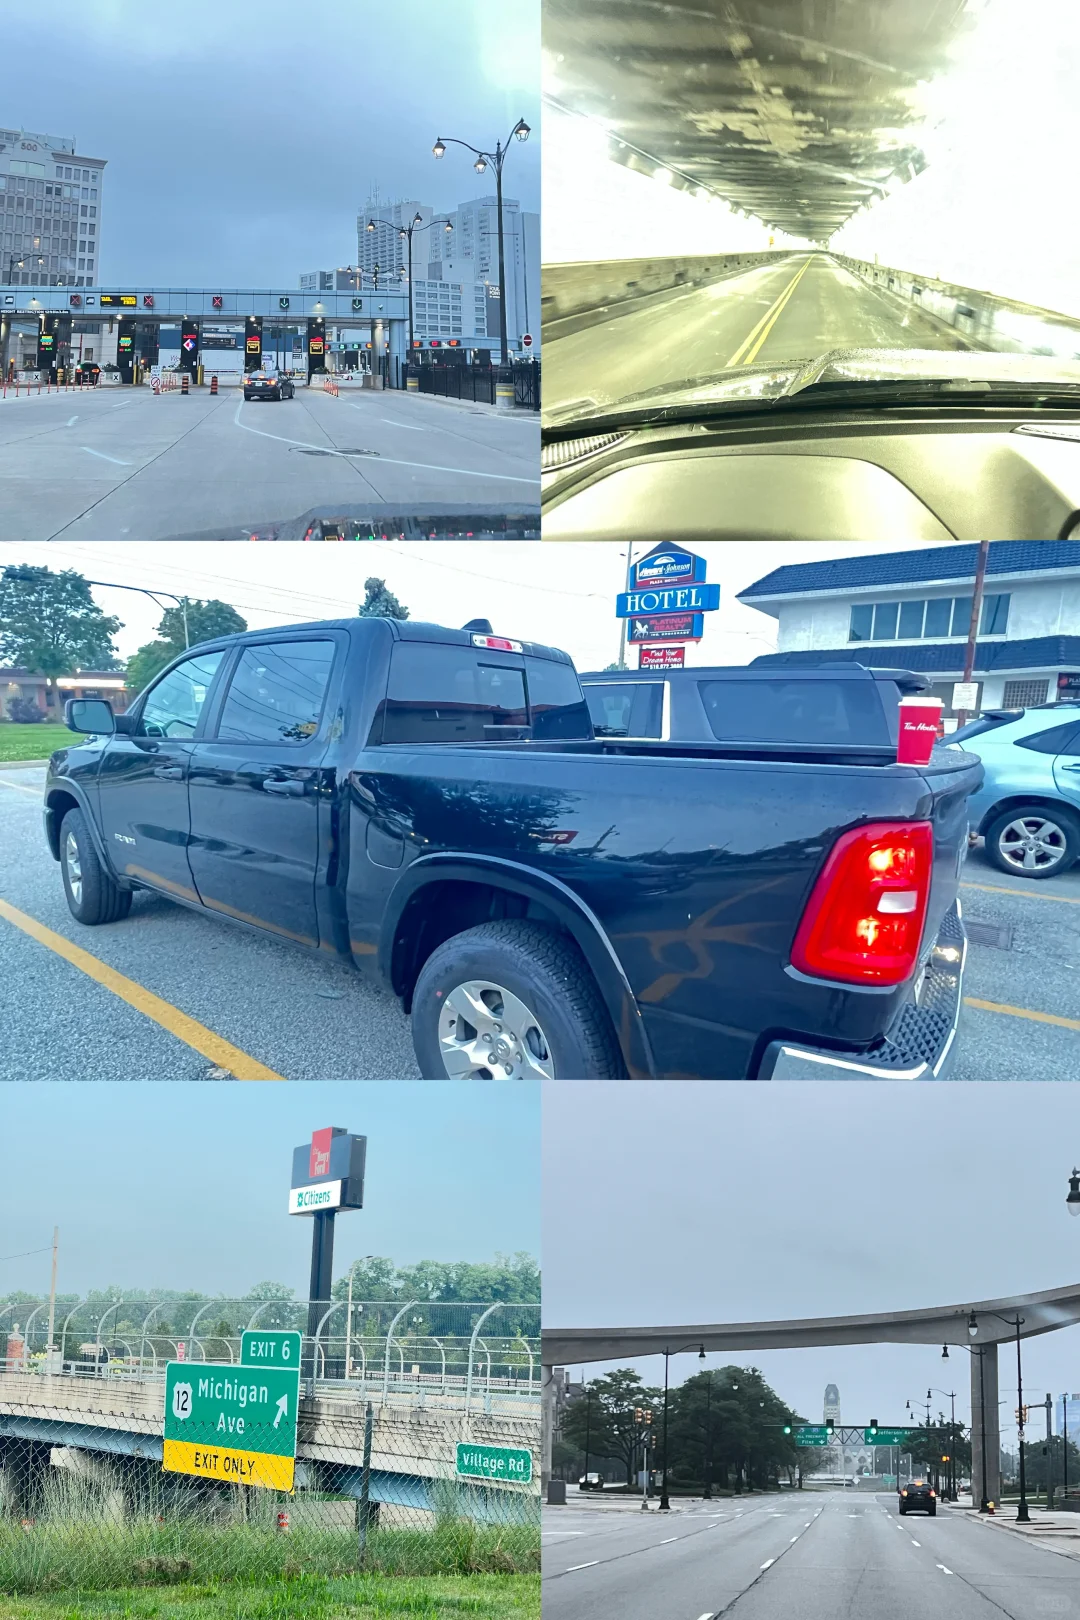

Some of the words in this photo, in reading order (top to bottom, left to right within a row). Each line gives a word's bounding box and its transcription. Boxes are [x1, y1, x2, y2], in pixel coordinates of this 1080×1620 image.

[21, 142, 37, 151] 500
[664, 563, 690, 574] Johnson
[626, 588, 702, 612] HOTEL
[649, 616, 692, 625] PLATINUM
[654, 623, 686, 631] REALTY
[643, 656, 664, 664] Dream
[904, 722, 916, 730] Tim
[315, 1160, 326, 1175] Ford
[303, 1190, 331, 1206] Citizens
[250, 1341, 276, 1357] EXIT
[281, 1340, 291, 1360] 6
[176, 1390, 189, 1411] 12
[198, 1377, 268, 1408] Michigan
[217, 1412, 245, 1434] Ave
[194, 1452, 219, 1470] EXIT
[223, 1457, 255, 1476] ONLY
[463, 1453, 504, 1472] Village
[508, 1458, 524, 1472] Rd
